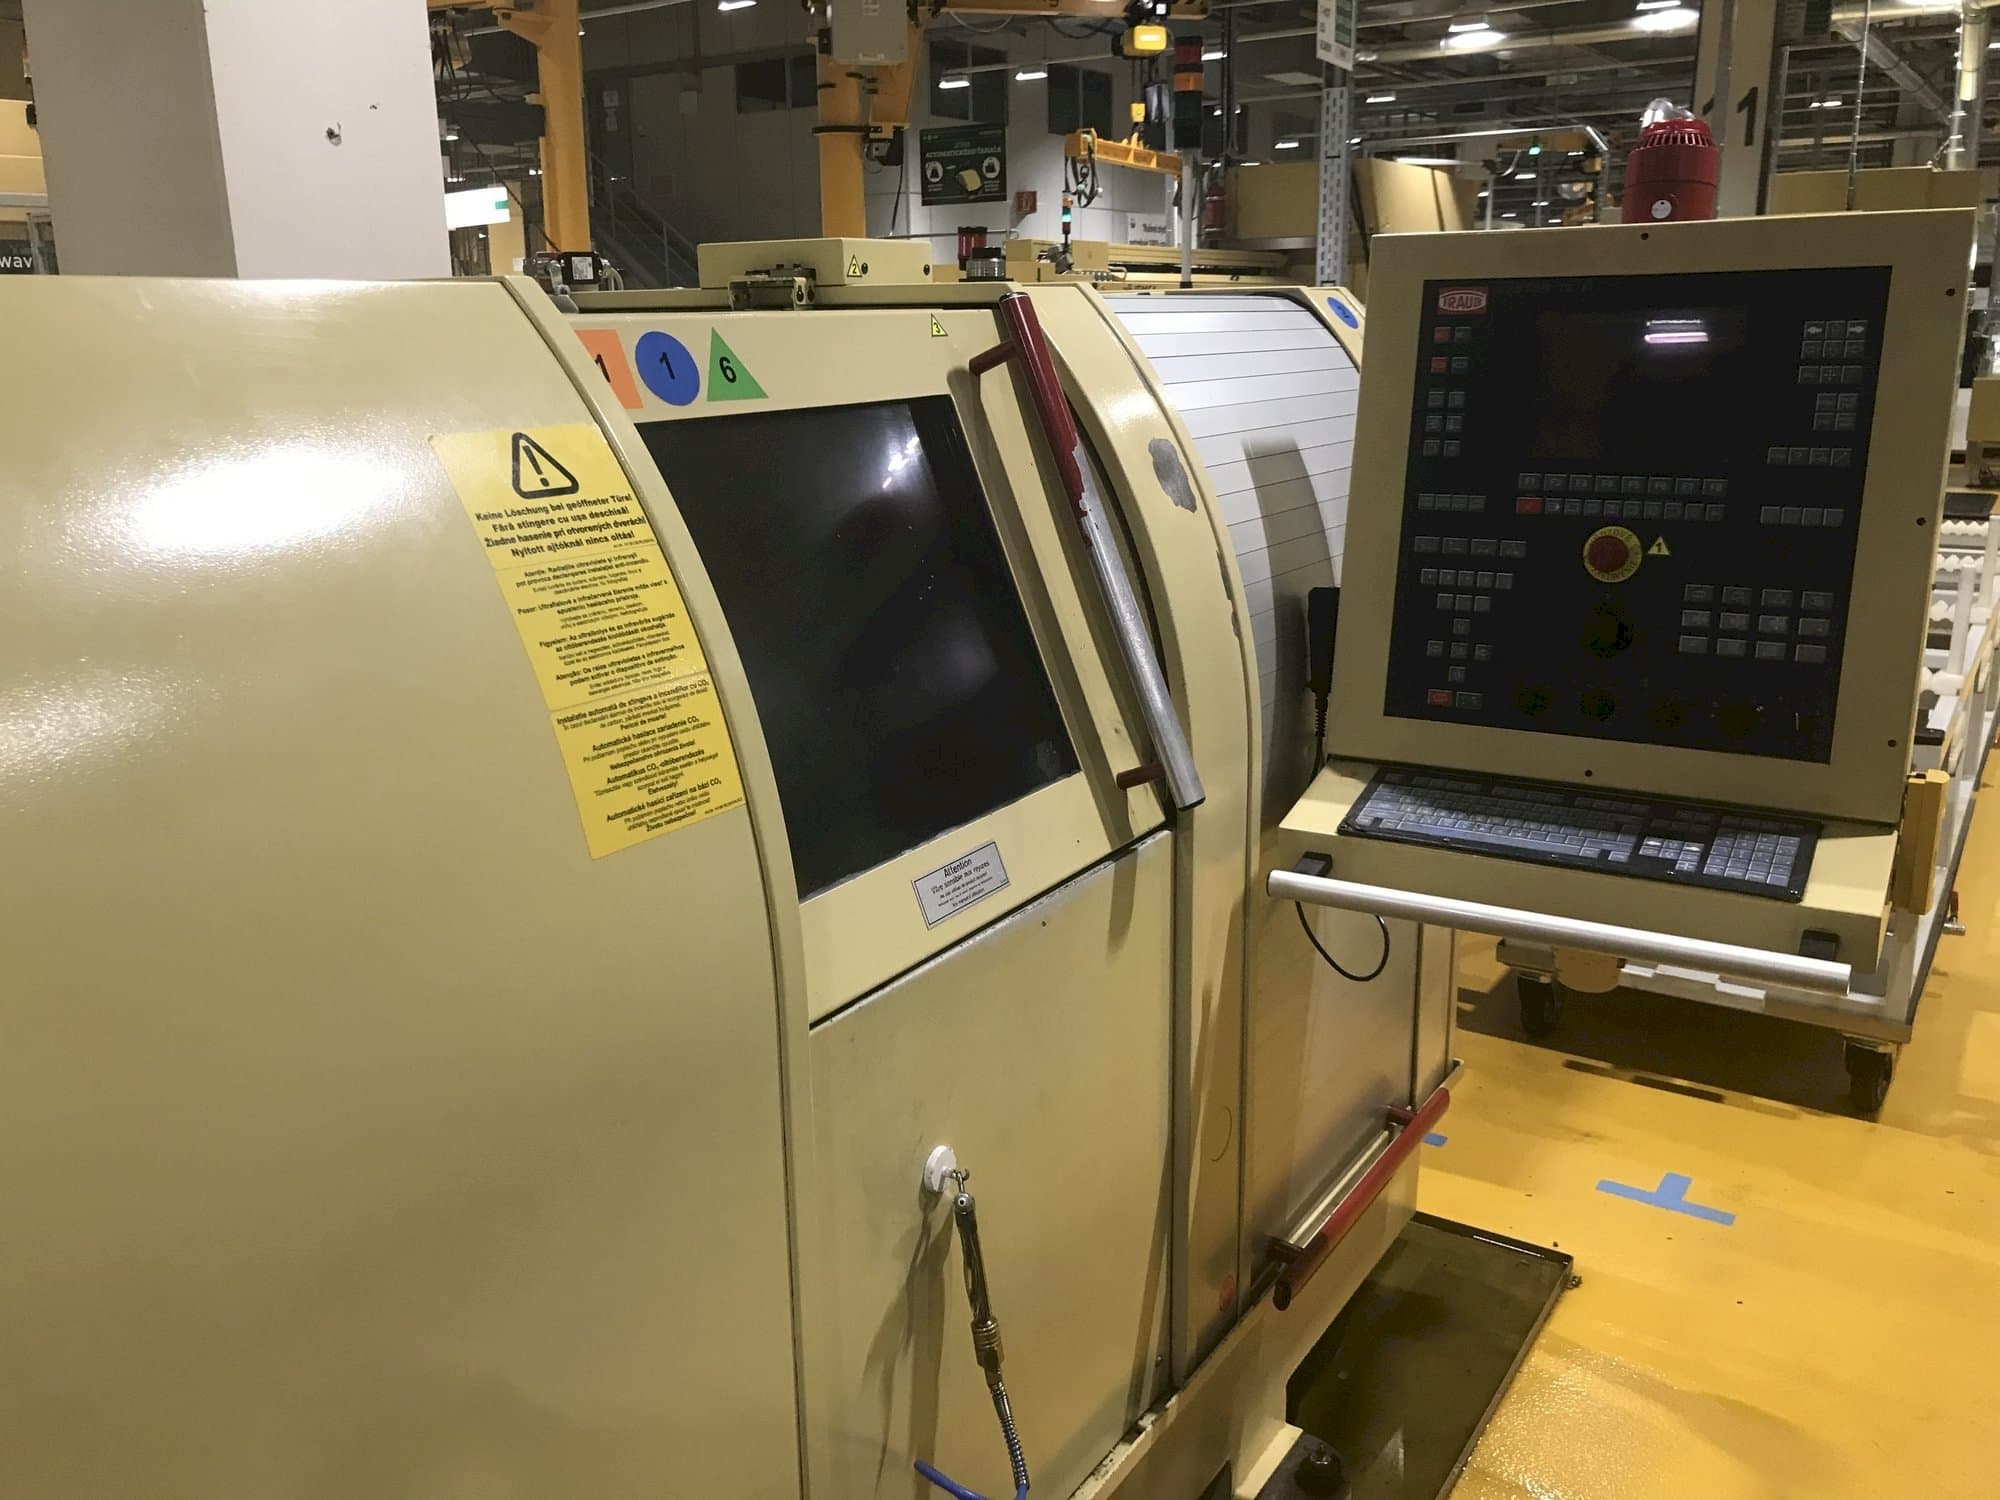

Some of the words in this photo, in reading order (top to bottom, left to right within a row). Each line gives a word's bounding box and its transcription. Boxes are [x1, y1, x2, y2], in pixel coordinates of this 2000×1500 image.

[1737, 86, 1759, 147] 1
[1441, 294, 1483, 311] TRAUB
[933, 322, 941, 334] 3
[594, 353, 611, 383] 1
[659, 351, 675, 380] 1
[719, 356, 737, 384] 6
[475, 512, 503, 521] Keine
[503, 506, 550, 517] Löschung
[549, 502, 565, 511] bei
[565, 497, 609, 511] geöffneter
[516, 518, 555, 529] stingere
[566, 521, 612, 535] otvorených
[510, 545, 545, 558] Nyitott
[546, 538, 584, 552] ajtóknál
[585, 536, 609, 545] nincs
[943, 858, 972, 878] Attention
